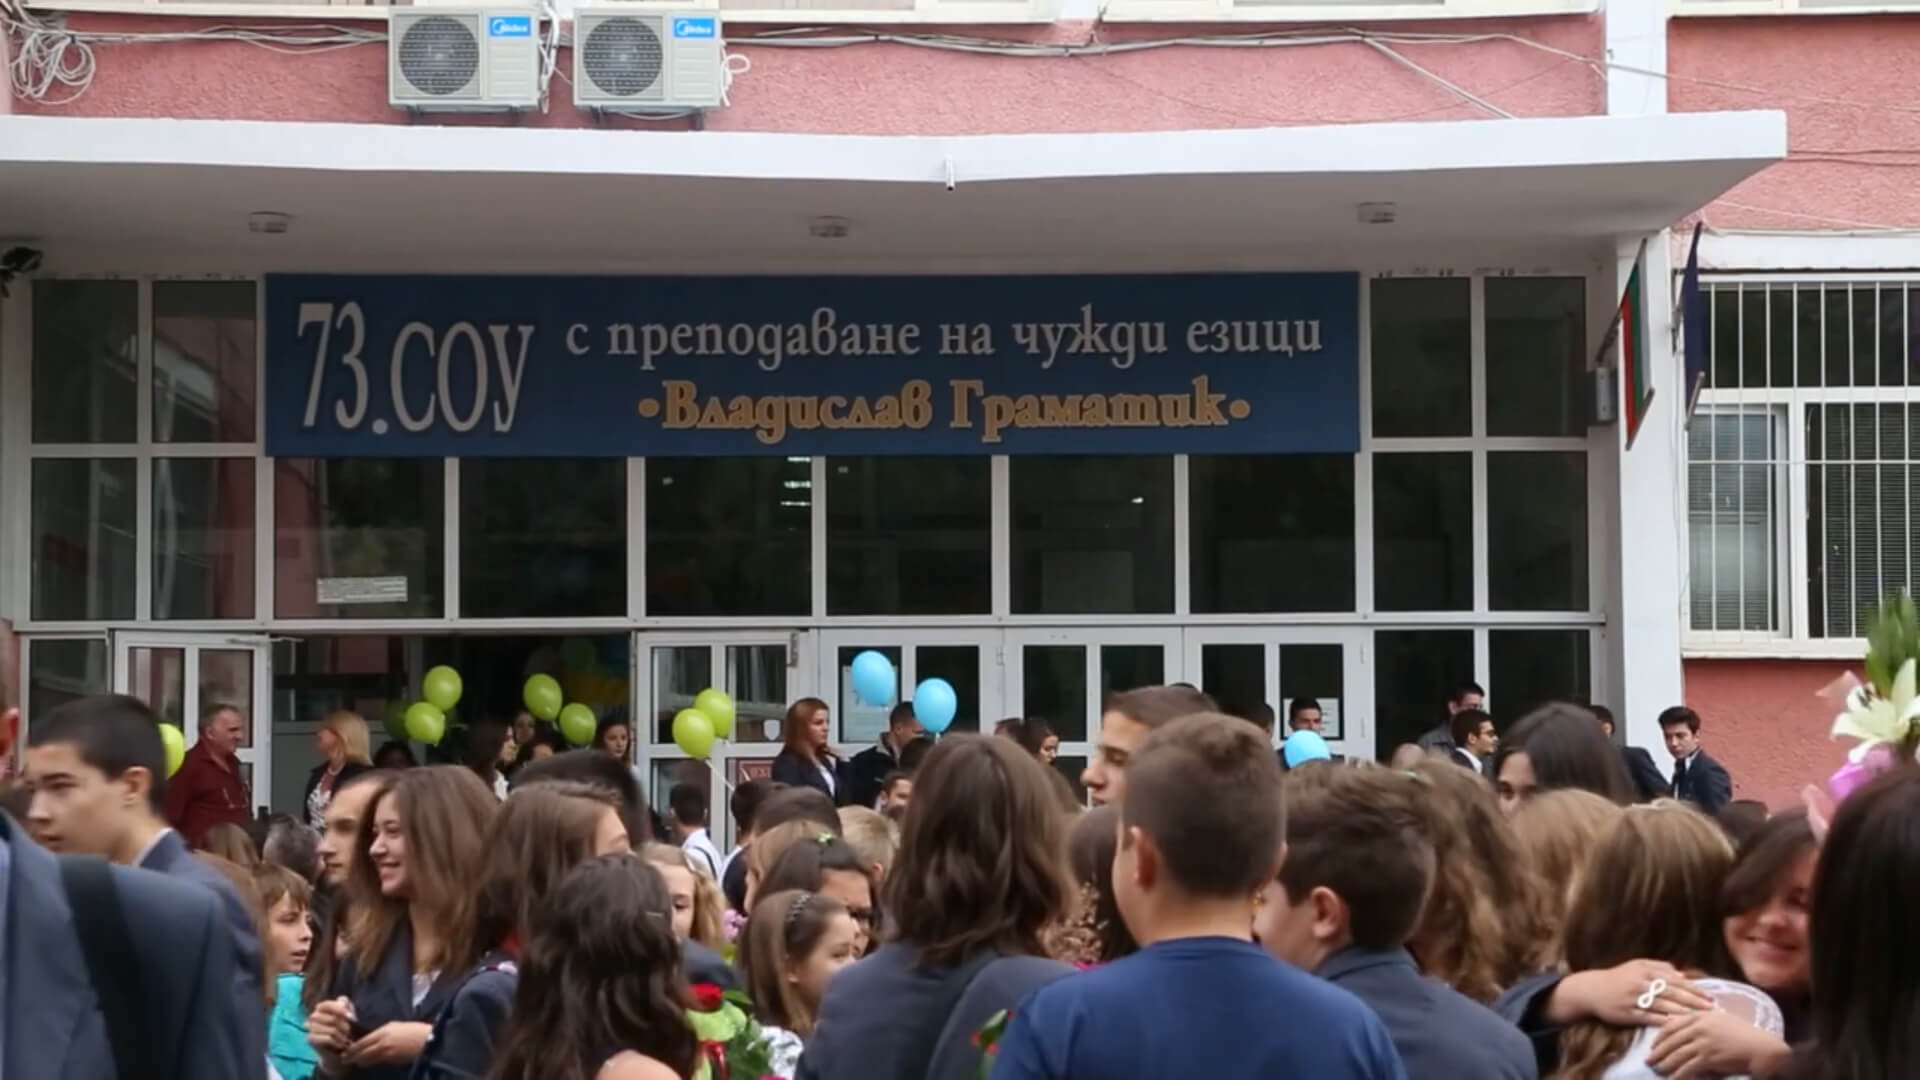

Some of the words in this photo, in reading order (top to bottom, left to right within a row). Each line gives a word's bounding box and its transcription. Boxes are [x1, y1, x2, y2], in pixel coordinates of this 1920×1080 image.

[565, 322, 591, 355] с
[607, 306, 921, 371] преподаване
[939, 322, 996, 355] на
[1011, 303, 1168, 369] чужди
[1186, 319, 1323, 358] езици
